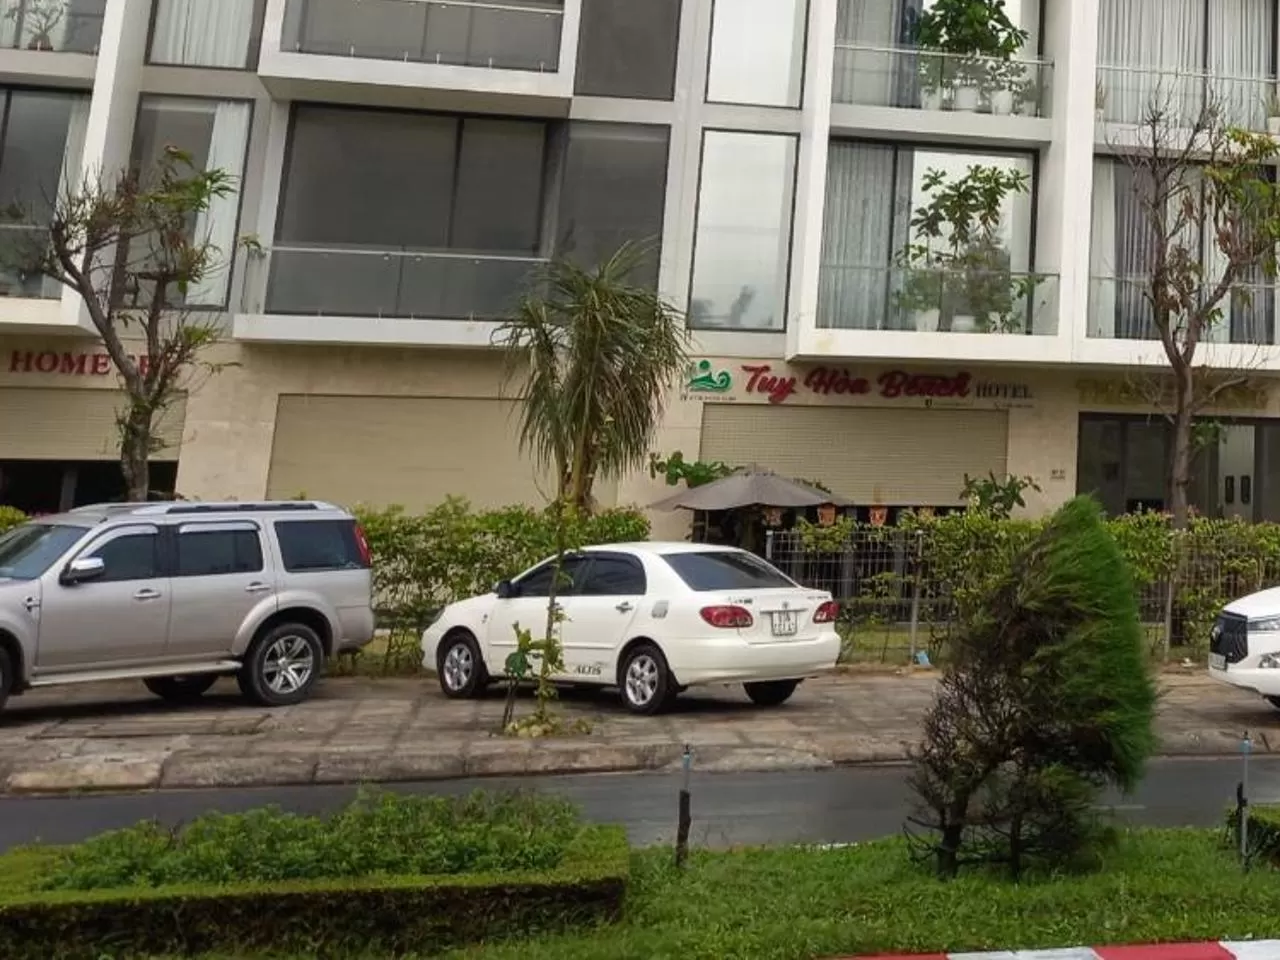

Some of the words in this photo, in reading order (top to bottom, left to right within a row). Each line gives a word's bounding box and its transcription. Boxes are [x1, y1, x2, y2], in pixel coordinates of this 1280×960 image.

[741, 364, 798, 404] Tuy
[803, 365, 870, 396] Hòa
[976, 379, 1033, 399] HOTEL
